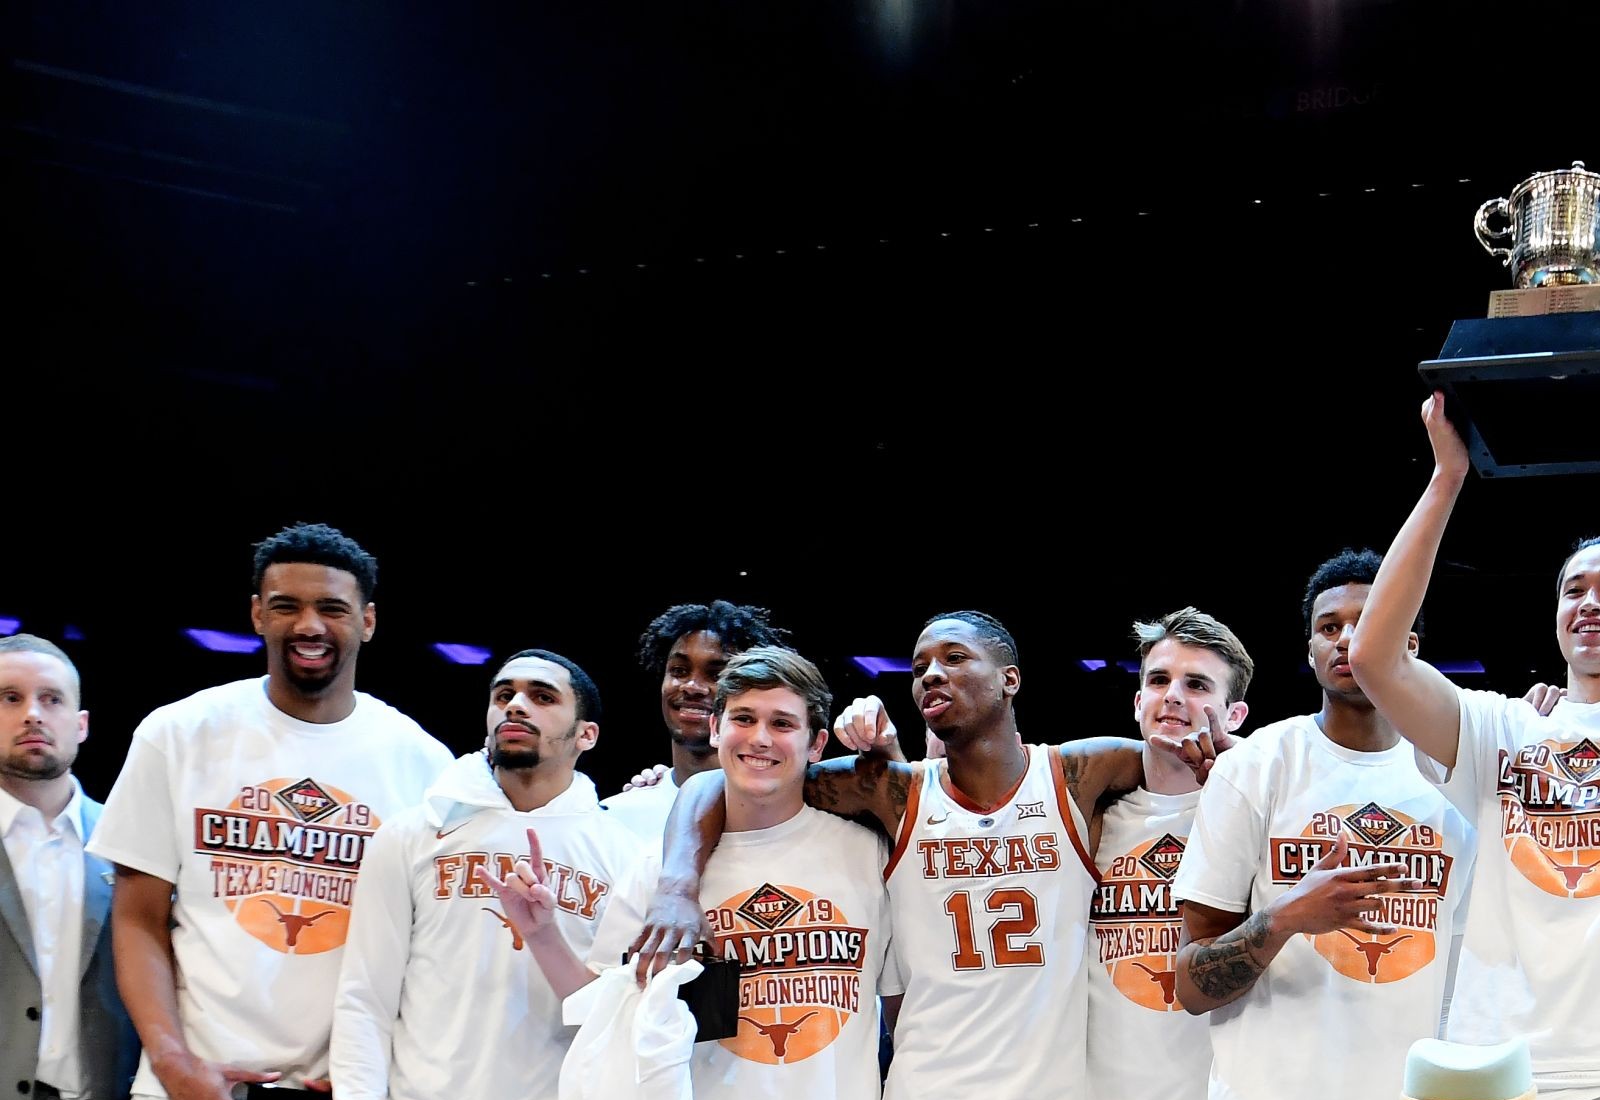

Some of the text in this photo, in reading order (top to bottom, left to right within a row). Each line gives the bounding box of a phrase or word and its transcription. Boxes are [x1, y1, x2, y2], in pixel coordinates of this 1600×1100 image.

[1521, 745, 1549, 767] 20
[1567, 757, 1600, 768] NIT
[240, 786, 371, 826] 20 NIT 19
[1313, 813, 1435, 846] 20 NIT 19
[917, 832, 1062, 879] TEXAS
[1112, 856, 1137, 877] 20
[210, 861, 276, 898] TEXAS
[706, 899, 833, 932] 20 NIT 19
[944, 887, 1046, 971] 12
[1095, 927, 1145, 963] TEXAS
[755, 976, 860, 1013] LONGHORNS
